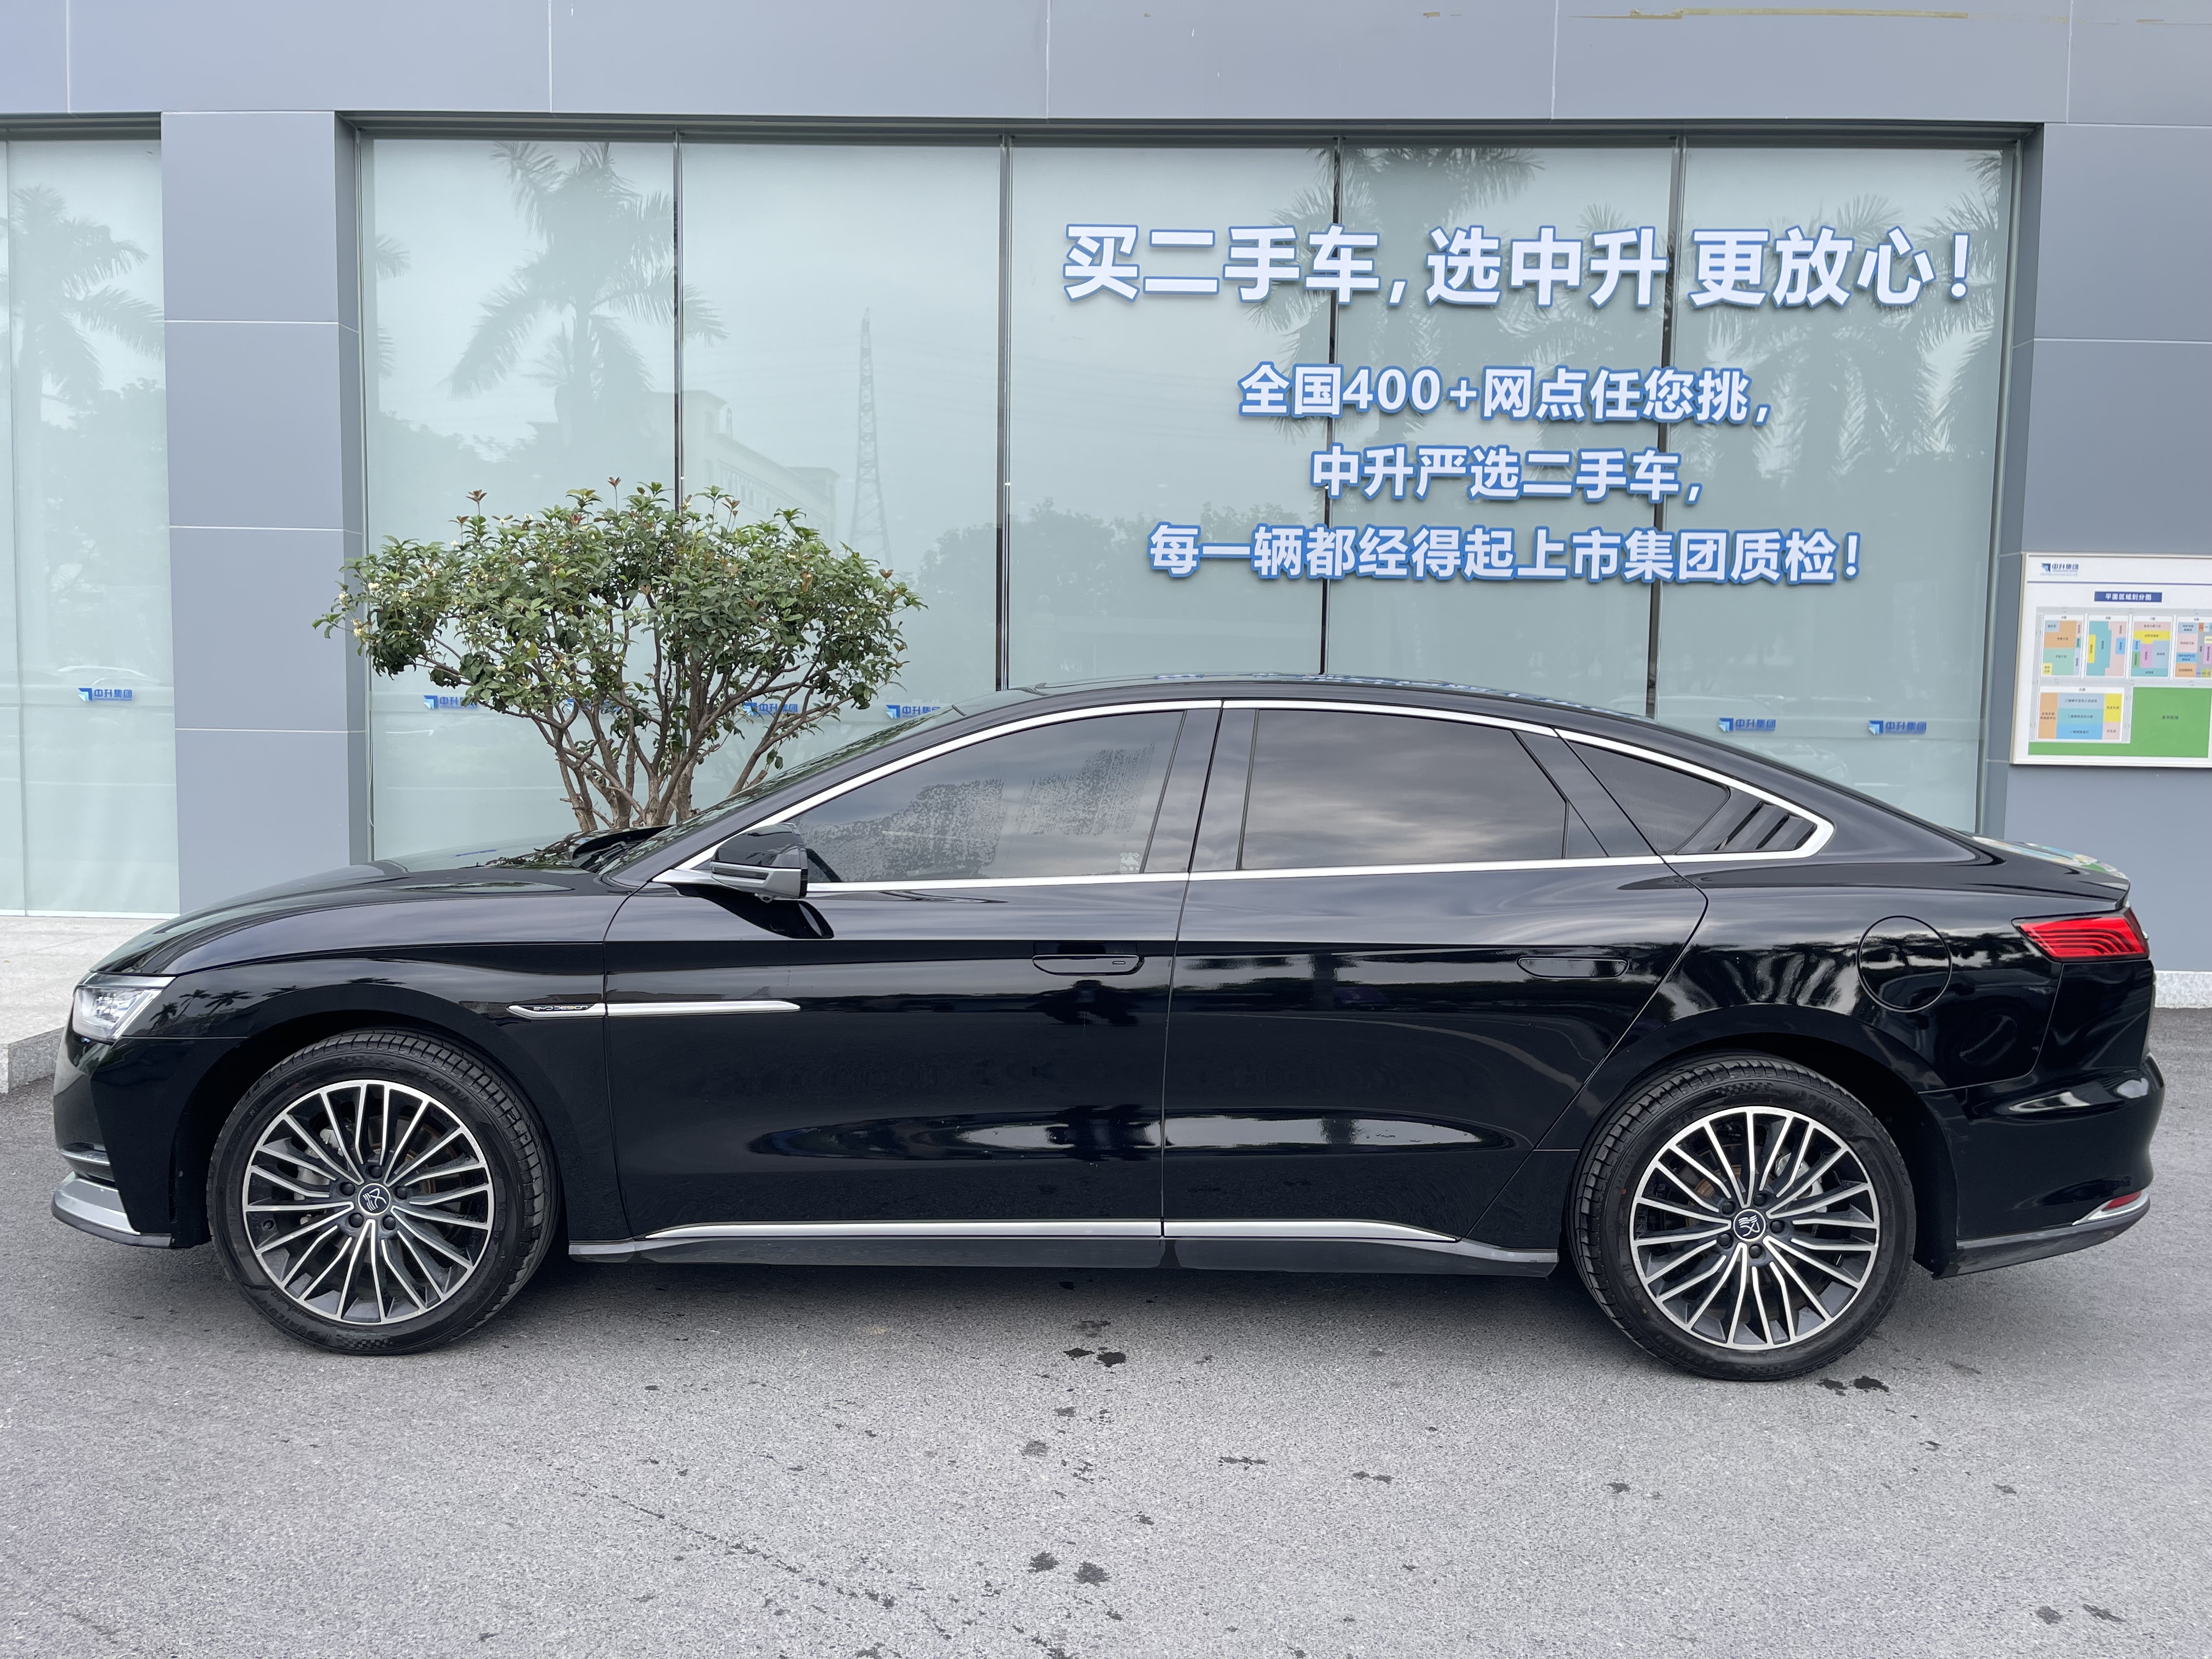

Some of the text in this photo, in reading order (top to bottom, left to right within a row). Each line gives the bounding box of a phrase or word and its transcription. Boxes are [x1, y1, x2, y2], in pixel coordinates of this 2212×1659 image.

[1238, 362, 1771, 425] 全国400+网点任您挑，
[1312, 444, 1703, 504] 中升严选二手车，
[1149, 524, 1861, 585] 每一辆都经得起上市集团质检！
[94, 689, 132, 698] 中升集团
[1736, 719, 1776, 727] 中升集团
[1886, 721, 1927, 730] 中升集团
